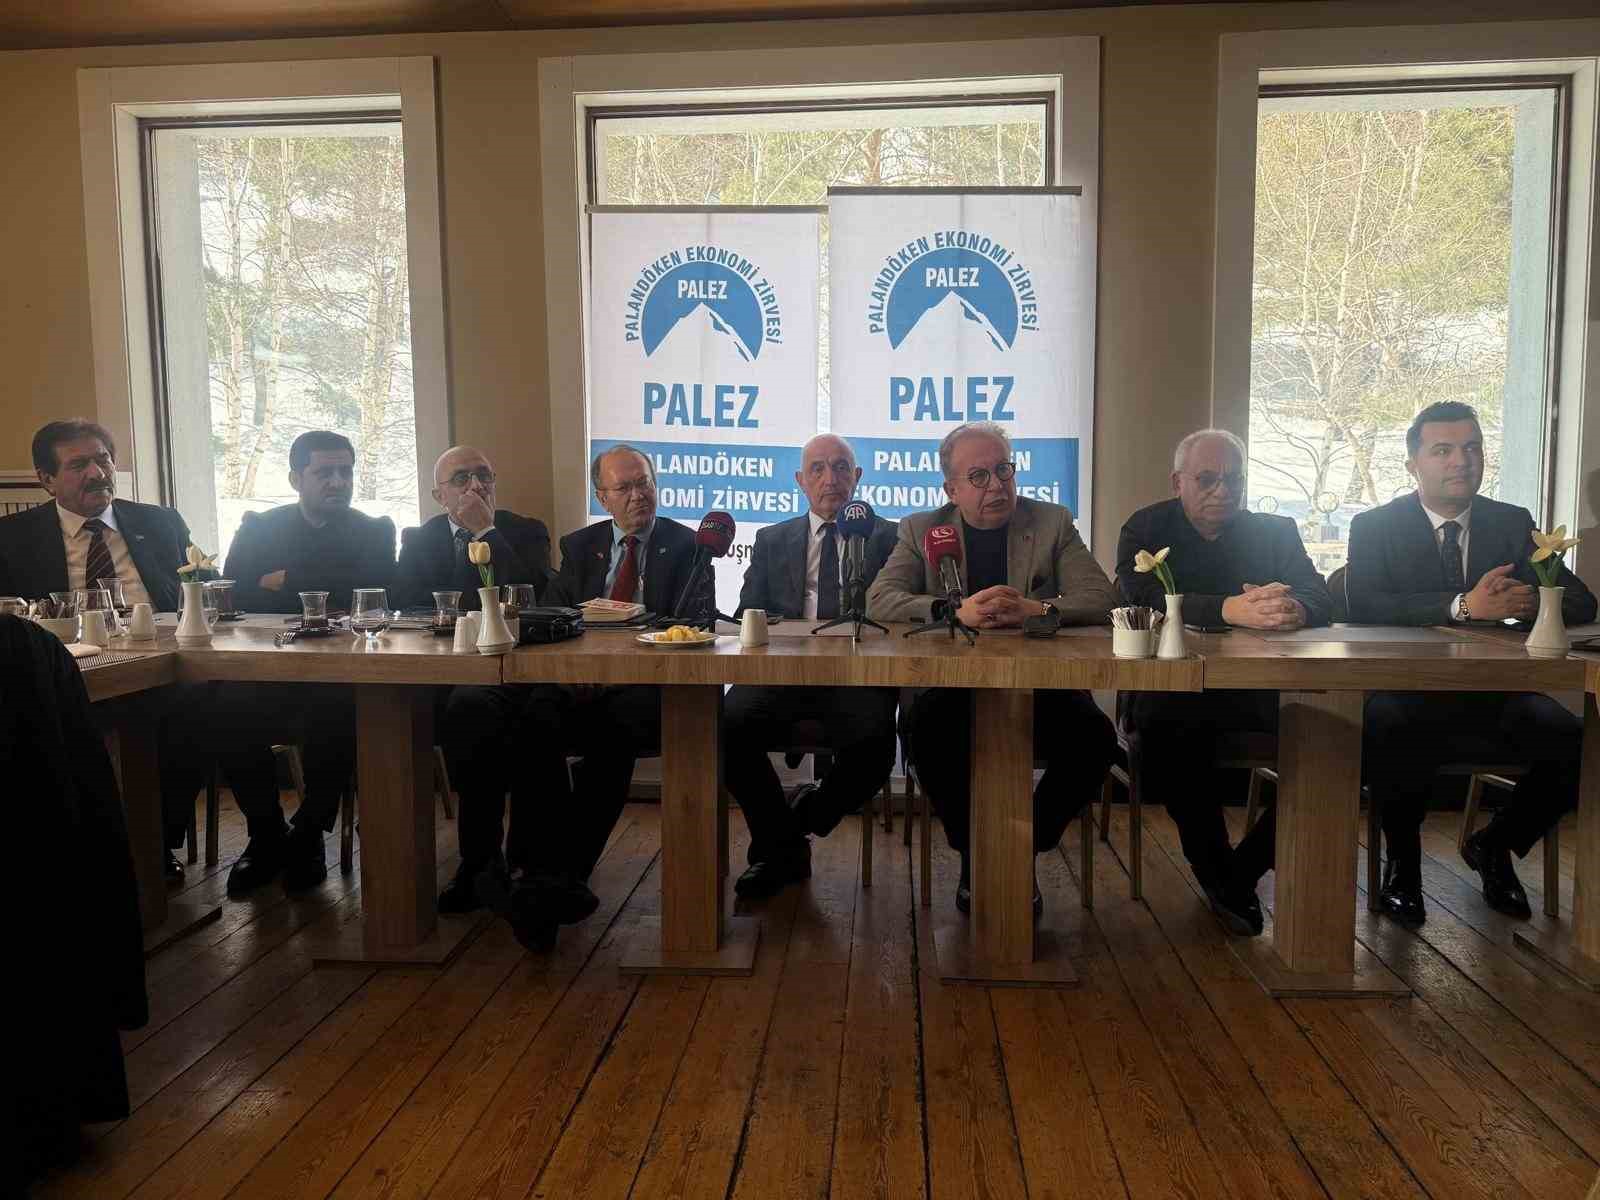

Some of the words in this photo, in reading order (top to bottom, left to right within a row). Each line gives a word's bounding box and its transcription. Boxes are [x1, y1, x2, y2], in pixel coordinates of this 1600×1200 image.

[678, 279, 728, 299] PALEZ
[869, 236, 931, 334] PALANDÖKEN
[934, 231, 1015, 266] EKONOMİ
[1008, 264, 1040, 331] ZİRVESİ
[925, 267, 980, 288] PALEZ
[626, 251, 682, 342] PALANDÖKEN
[686, 246, 760, 280] EKONOMİ
[754, 278, 782, 345] ZİRVESİ
[643, 381, 760, 428] PALEZ
[889, 376, 1015, 421] PALEZ
[648, 452, 774, 477] LANDÖKEN
[711, 485, 800, 513] ZİRVESİ
[854, 484, 949, 508] KONOM
